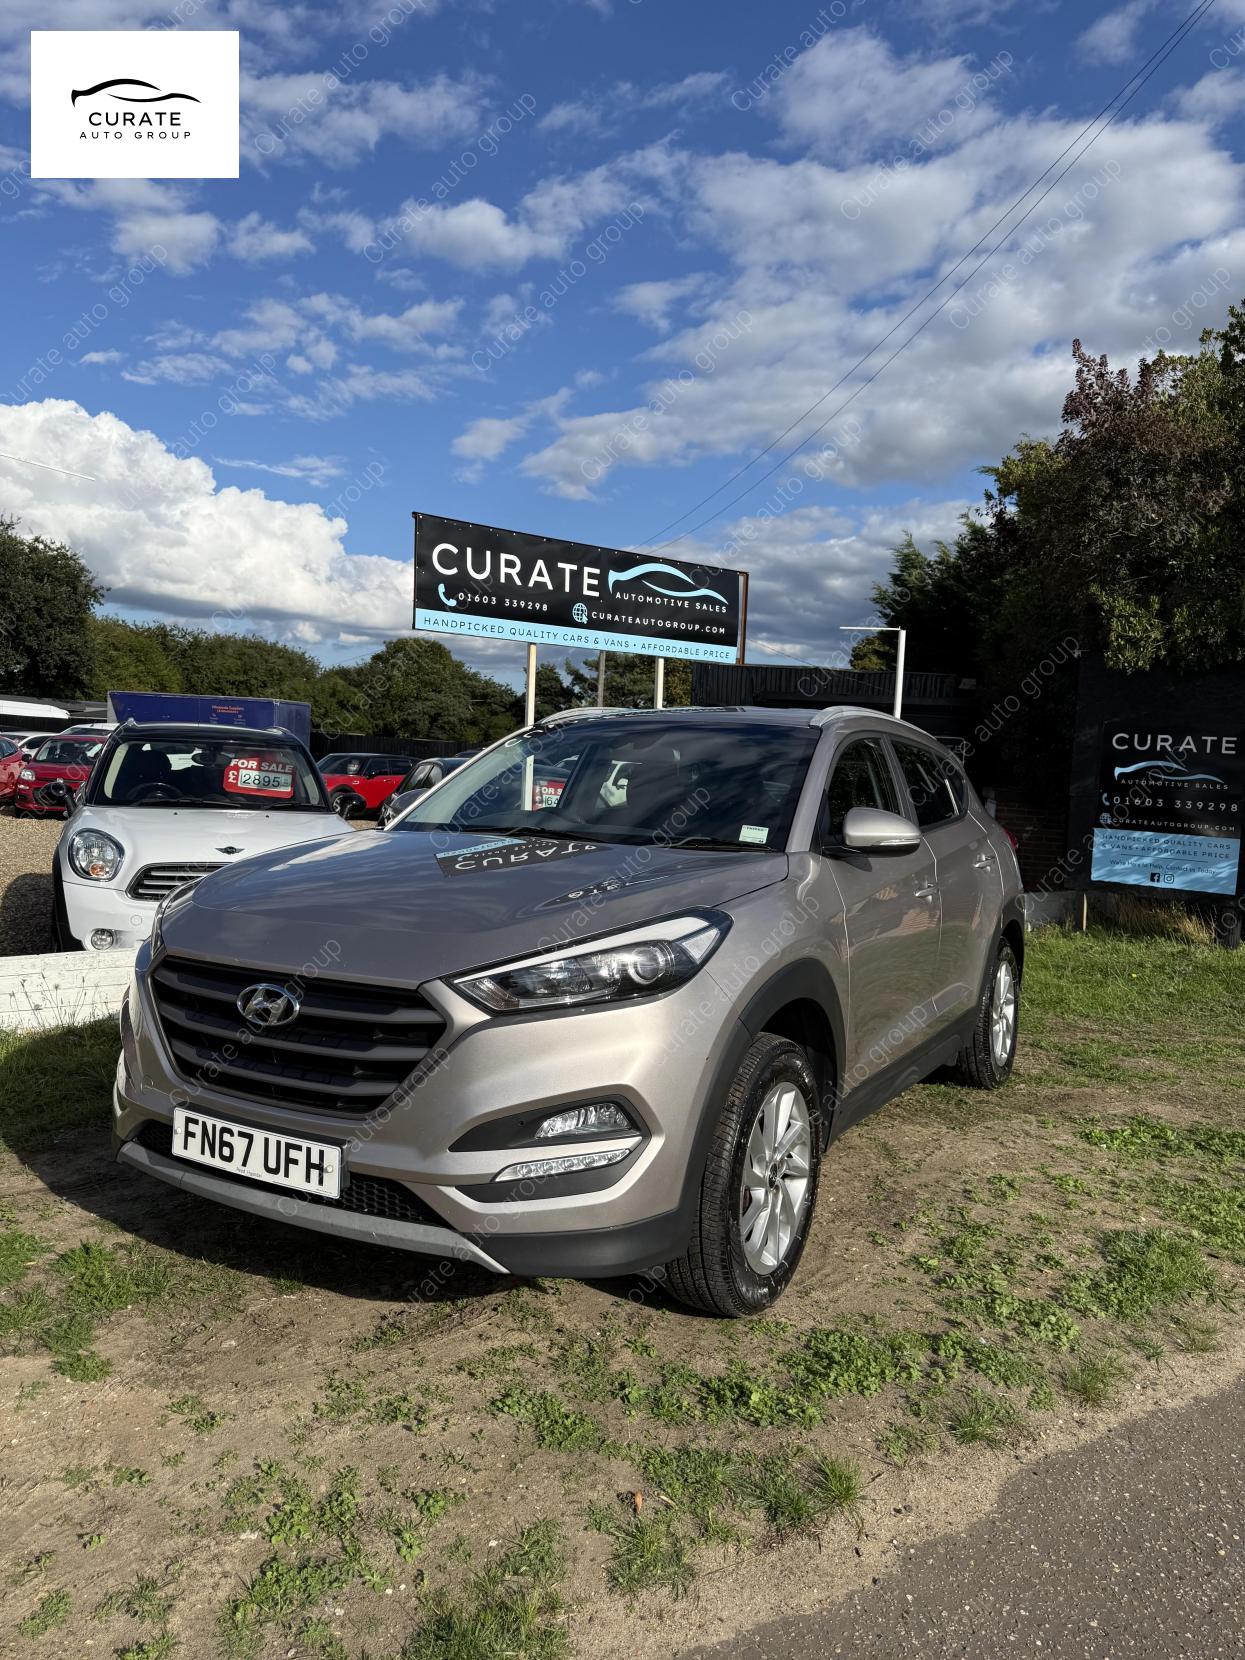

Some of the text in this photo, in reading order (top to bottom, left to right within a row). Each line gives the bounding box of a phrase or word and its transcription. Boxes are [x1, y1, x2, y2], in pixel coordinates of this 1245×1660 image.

[432, 543, 600, 597] CURATE
[458, 592, 548, 611] 01603 339298
[616, 592, 727, 613] AUTOMOTIVE SALES
[591, 611, 725, 634] CURATEAUTOGROUP.COM
[424, 617, 504, 634] HANDPICKED
[510, 627, 559, 640] QUALITY
[563, 634, 589, 644] CARS
[604, 638, 630, 648] VANS
[641, 643, 700, 656] AFFORDABLE
[703, 649, 730, 659] PRICE
[1112, 733, 1238, 754] CURATE
[230, 759, 294, 773] FOR SALE
[228, 770, 280, 787] £ 2895
[1121, 779, 1189, 788] AUTOMOTIVE
[1113, 796, 1238, 812] 01603 339298
[1113, 817, 1235, 831] CURATEAUTOGROUP.COM
[1103, 834, 1231, 850] HANDPICKED QUALITY CARS
[1111, 843, 1133, 851] VANS
[1202, 851, 1230, 859] PRICE
[184, 1116, 254, 1167] FN67
[264, 1137, 324, 1186] UFH
